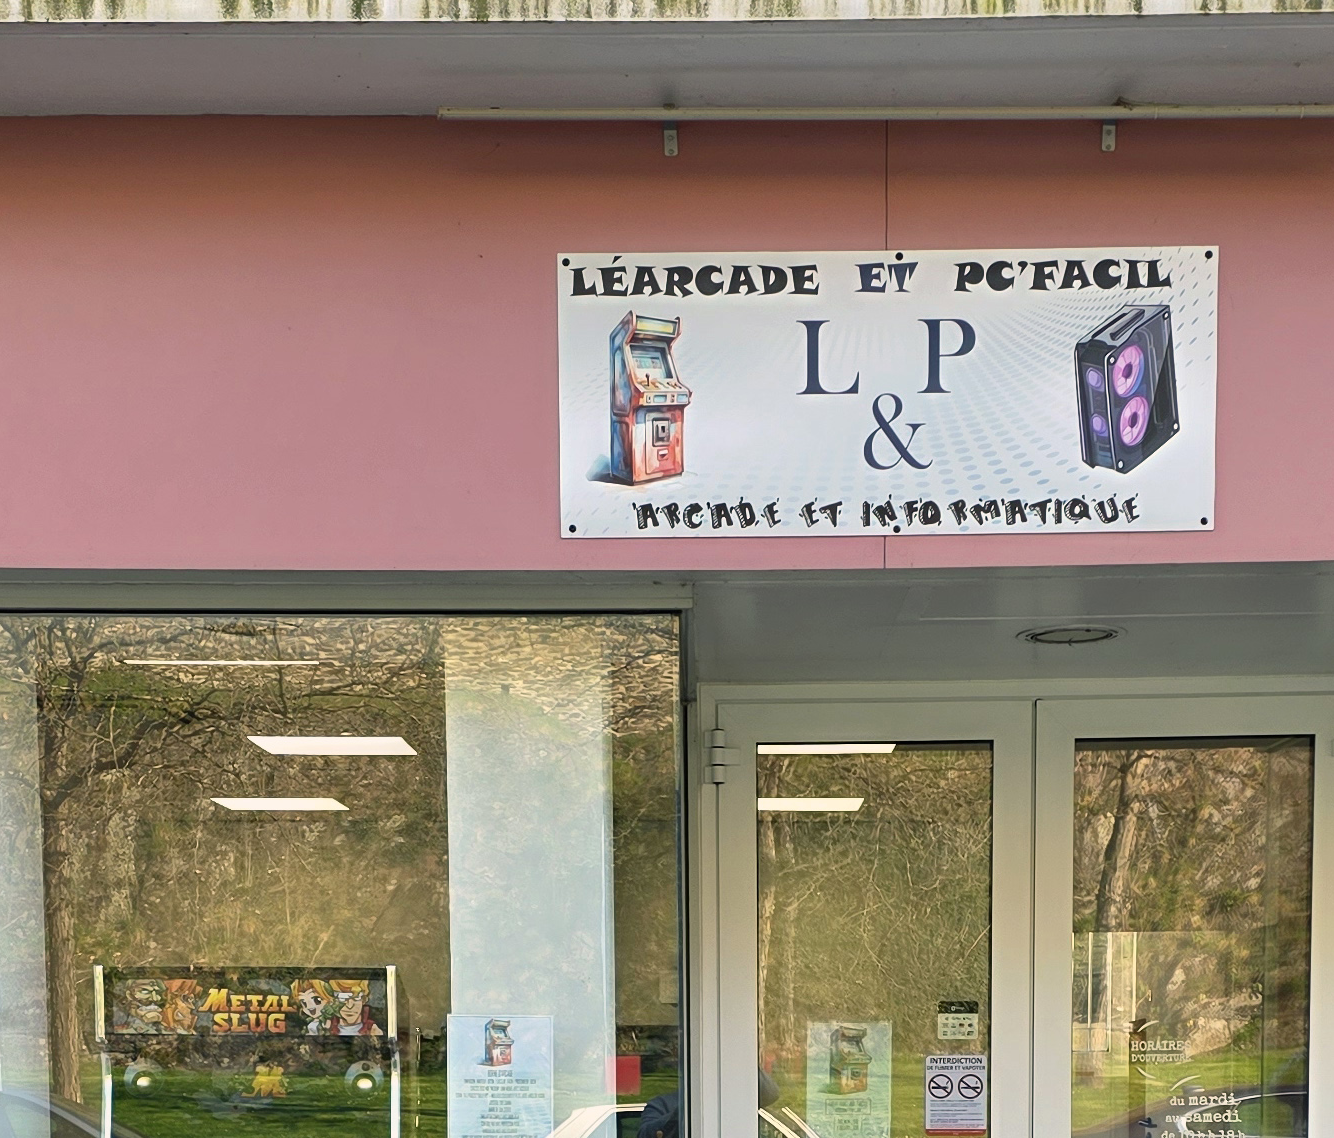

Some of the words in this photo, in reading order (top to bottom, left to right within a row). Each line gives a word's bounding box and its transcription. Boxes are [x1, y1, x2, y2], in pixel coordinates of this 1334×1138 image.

[569, 255, 819, 298] LÉARCADE
[855, 259, 919, 294] ET
[955, 257, 1172, 294] PC'FACIL
[795, 318, 860, 396] L
[917, 317, 977, 395] P
[862, 392, 933, 471] &
[634, 495, 781, 531] ARCADE
[801, 496, 843, 529] ET
[861, 492, 1141, 529] INFORMATIQUE
[198, 988, 298, 1013] METAL
[212, 1013, 287, 1033] SLUG
[1130, 1040, 1191, 1051] HORAIRES
[930, 1057, 983, 1065] INTERDICTION
[1169, 1096, 1184, 1106] du
[1189, 1093, 1236, 1106] mardi
[1184, 1110, 1242, 1123] samedi
